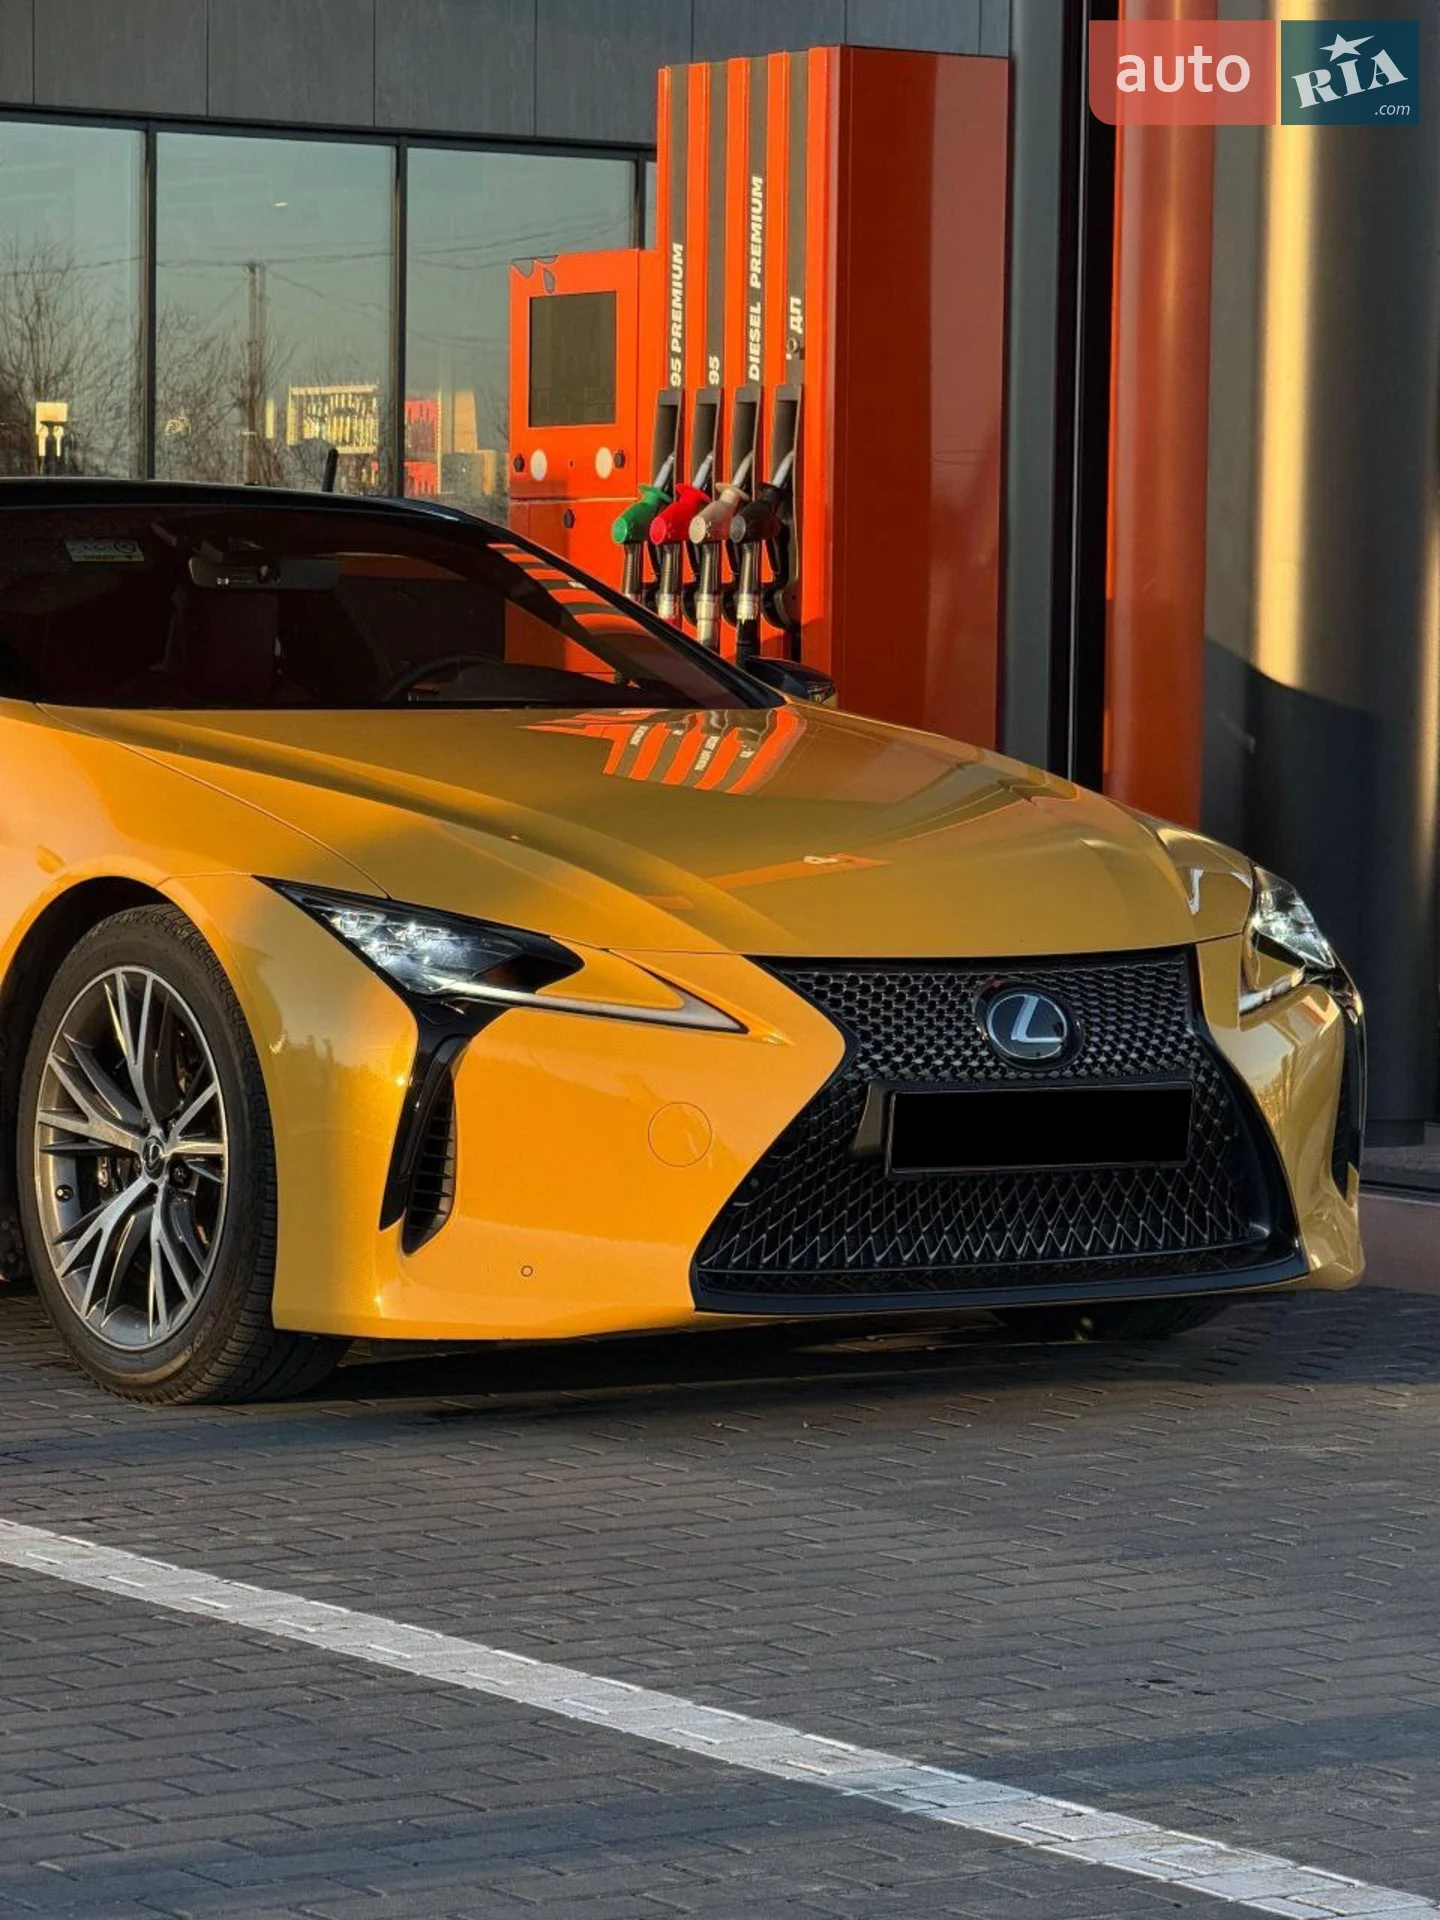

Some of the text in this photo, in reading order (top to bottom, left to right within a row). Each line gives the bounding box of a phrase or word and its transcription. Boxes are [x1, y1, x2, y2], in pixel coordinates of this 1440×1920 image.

[670, 242, 684, 387] 95 PREMIUM
[748, 176, 763, 382] DIESEL PREMIUM
[789, 295, 803, 335] ДП
[708, 355, 721, 385] 95
